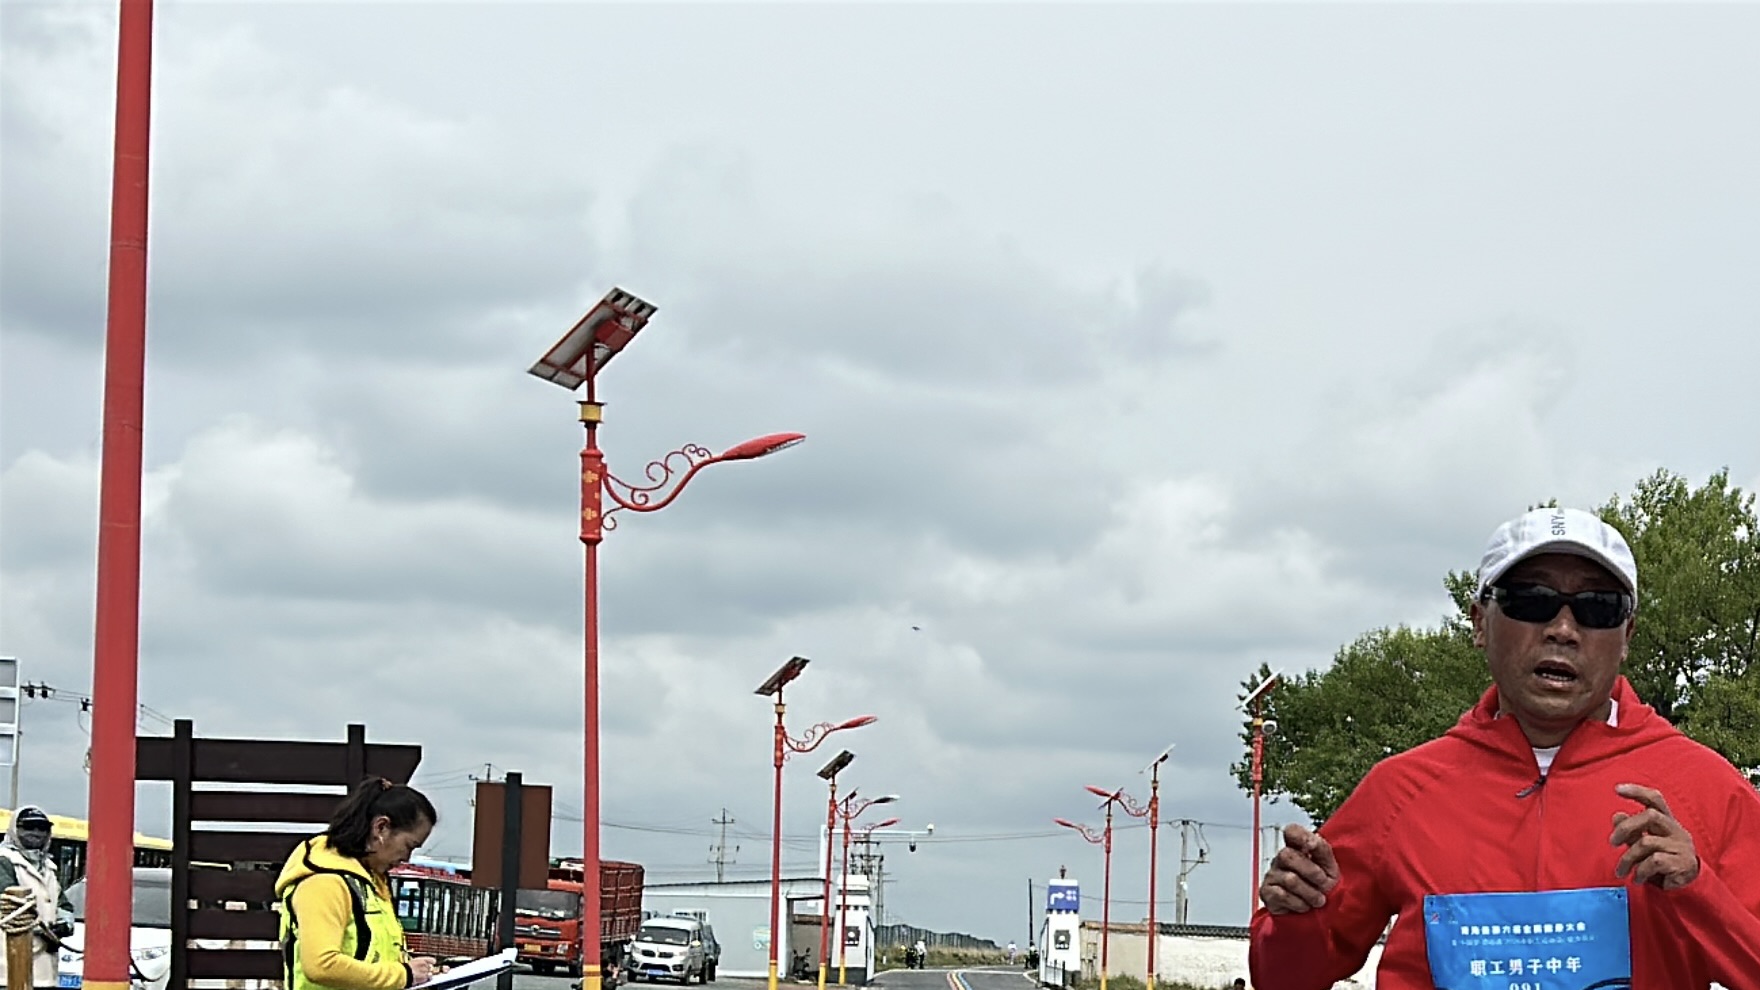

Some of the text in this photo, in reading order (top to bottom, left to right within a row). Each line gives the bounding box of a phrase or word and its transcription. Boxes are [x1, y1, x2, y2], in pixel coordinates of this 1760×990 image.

[1470, 957, 1582, 976] 职工男子中年
